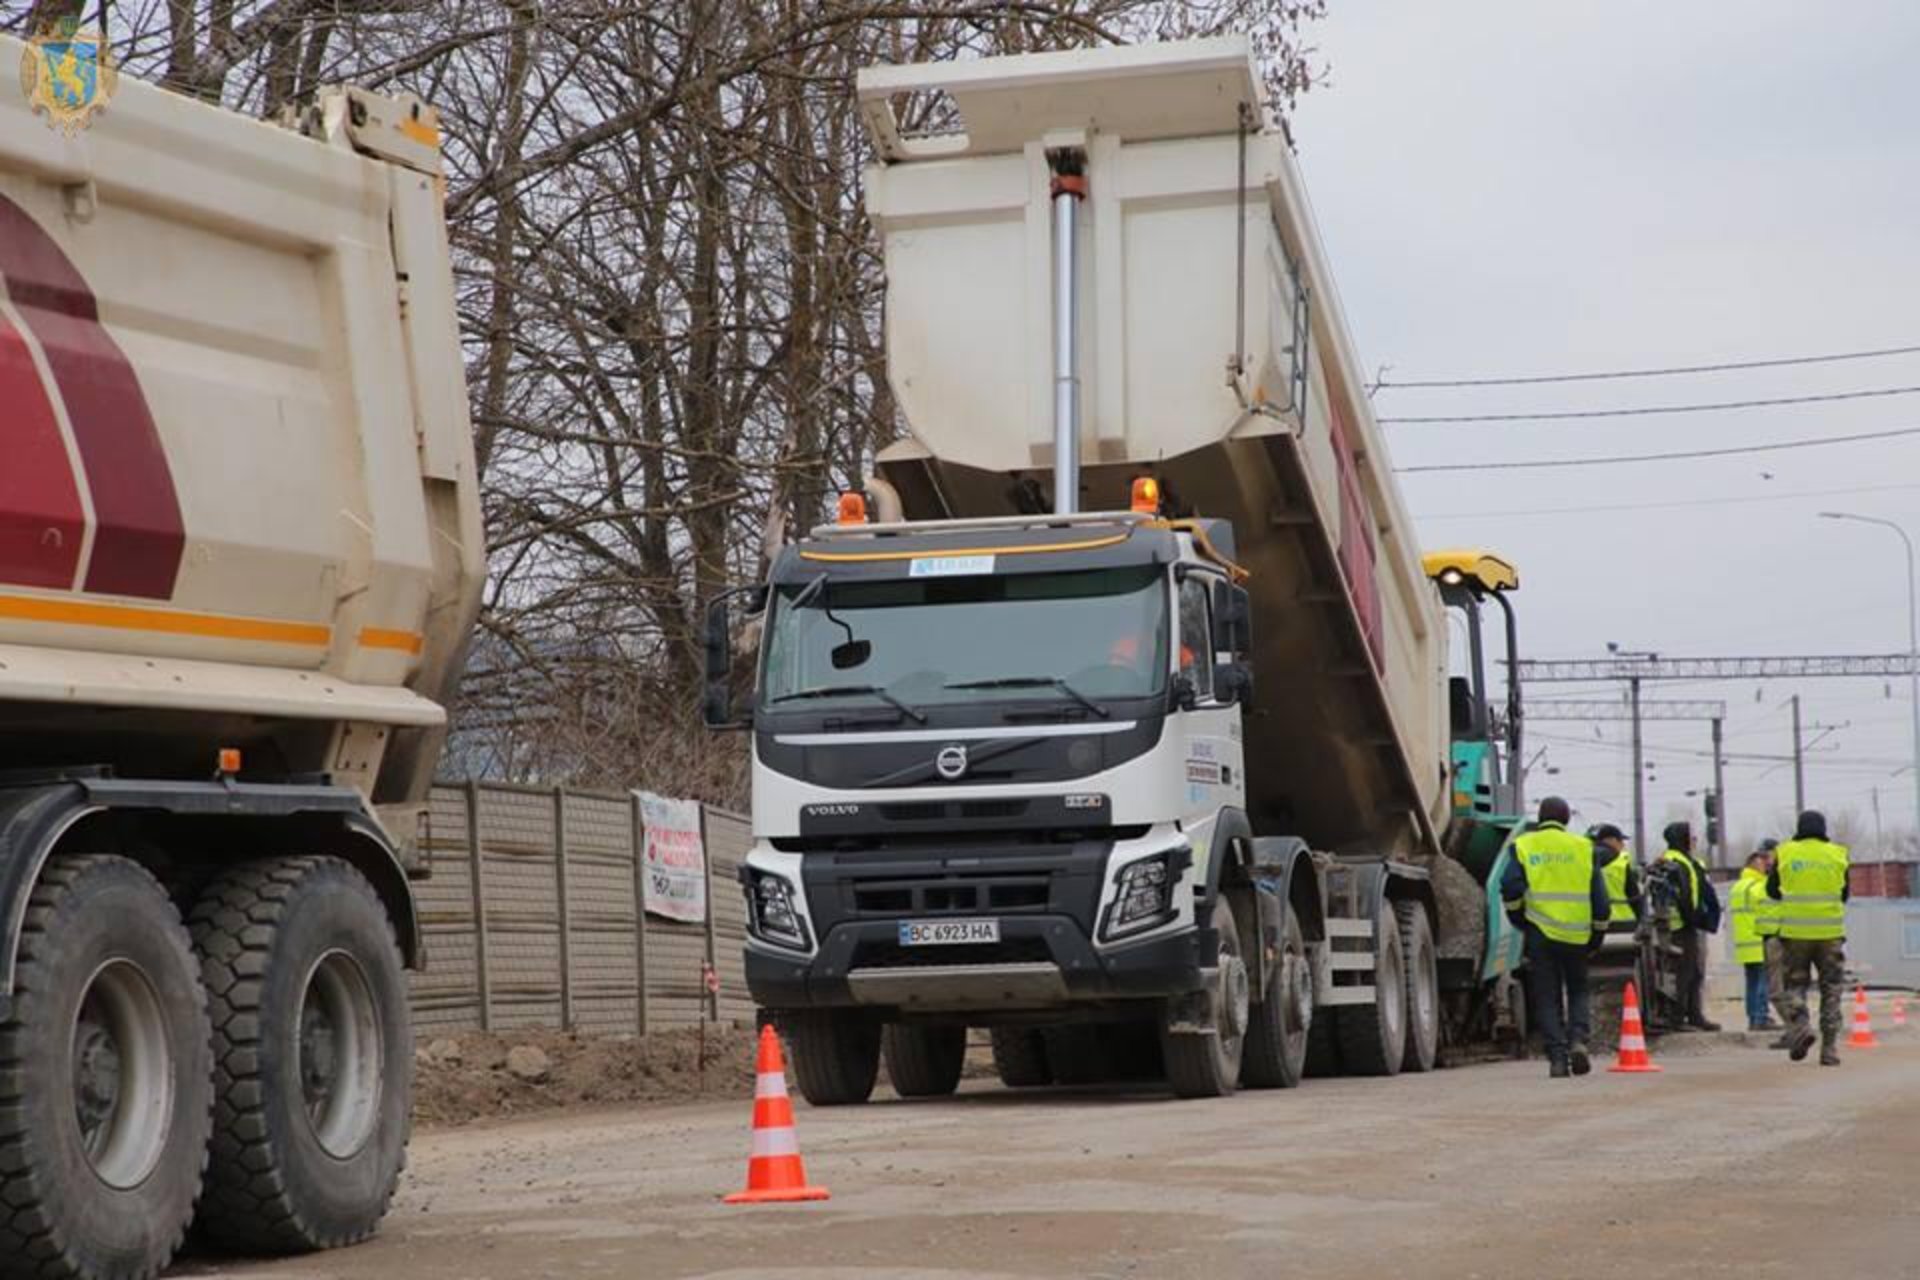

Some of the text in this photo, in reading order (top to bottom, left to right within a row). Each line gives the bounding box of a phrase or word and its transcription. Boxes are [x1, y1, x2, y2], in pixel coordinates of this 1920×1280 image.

[807, 805, 859, 815] VOLVO
[911, 923, 993, 941] BC 6923 HA
